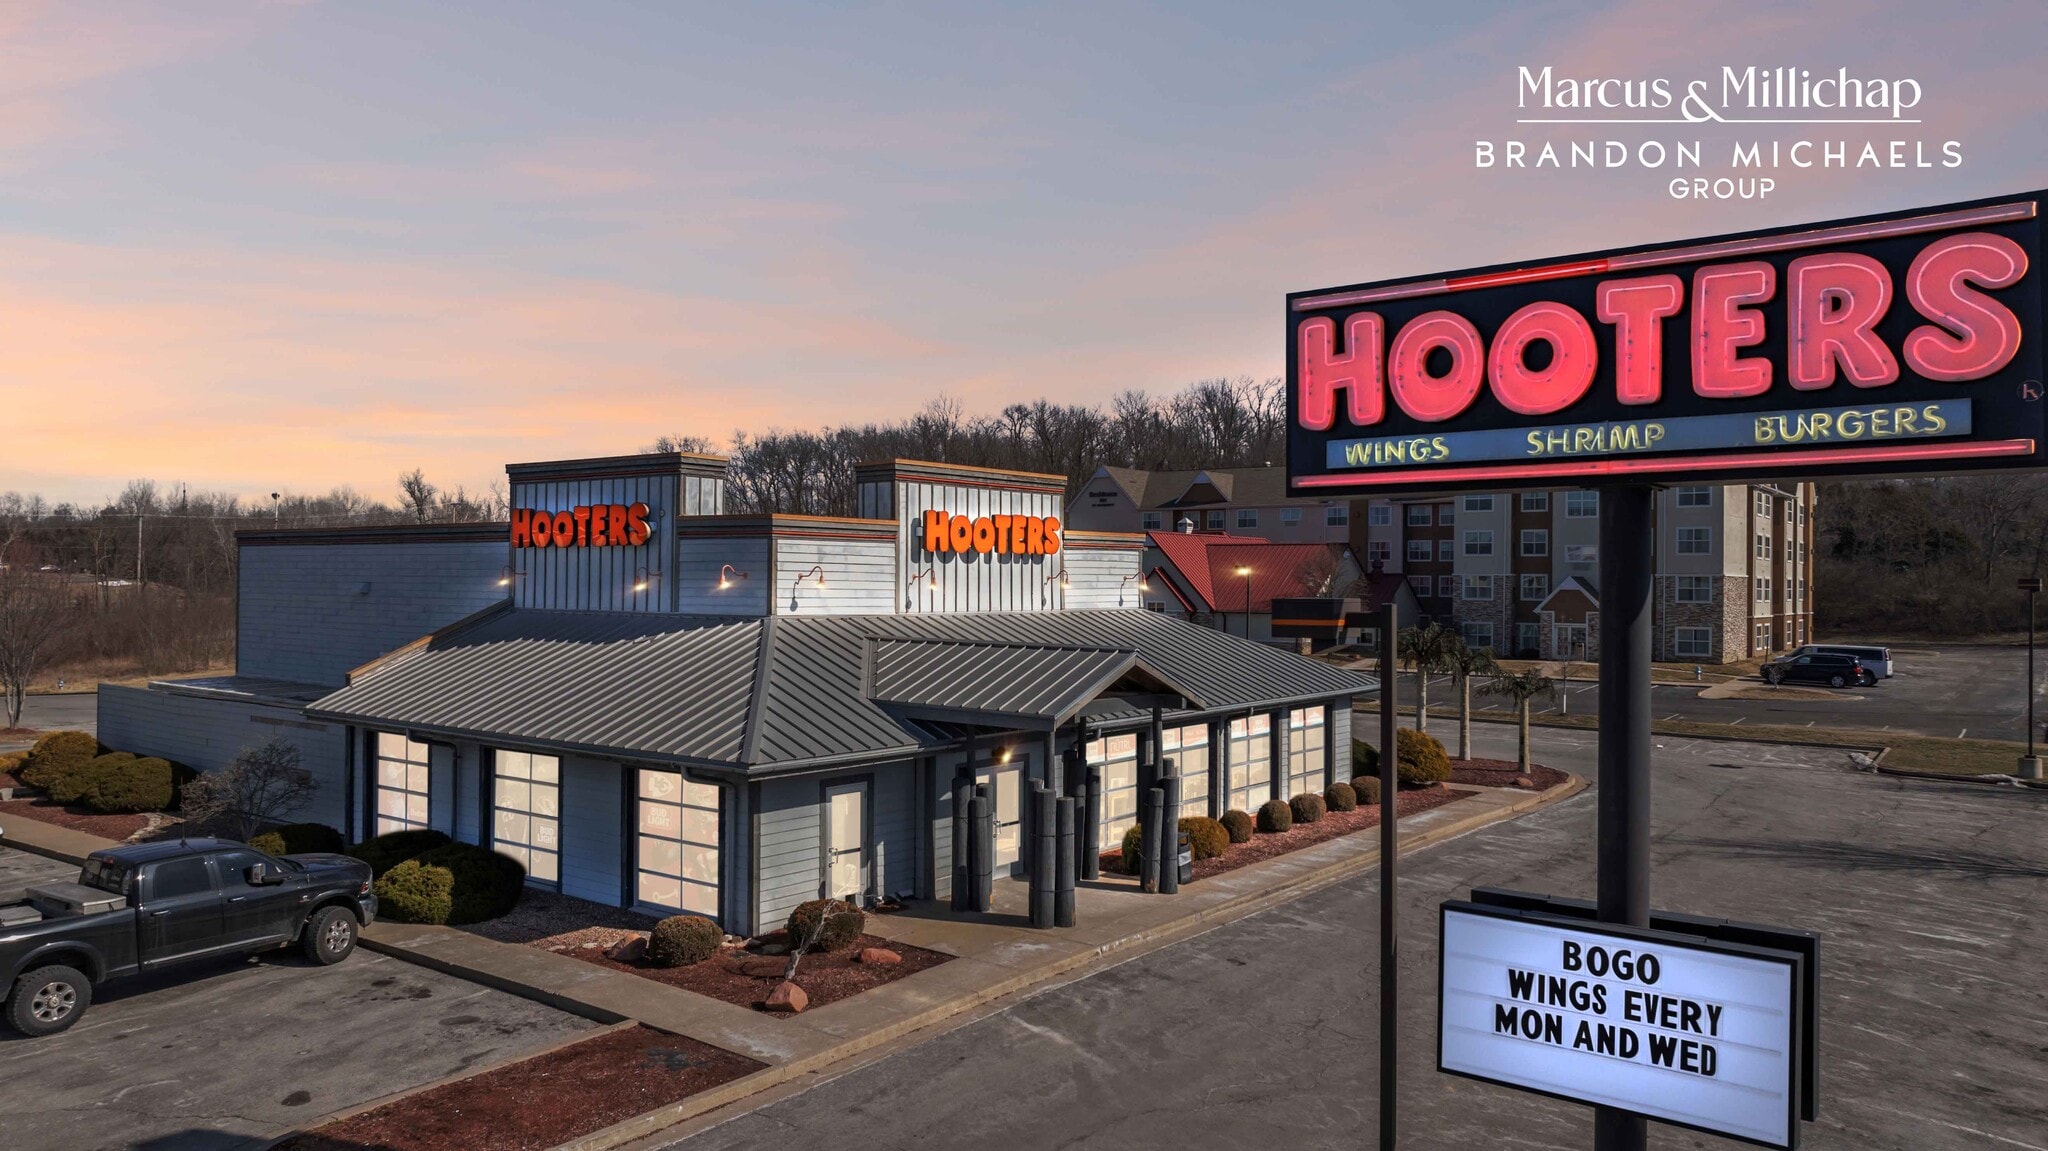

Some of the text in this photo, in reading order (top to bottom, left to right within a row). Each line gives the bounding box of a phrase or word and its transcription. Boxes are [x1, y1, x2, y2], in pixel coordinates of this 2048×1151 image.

[1297, 231, 2030, 431] HOOTERS
[1345, 405, 1946, 465] WINGS SHRIMP BURGERS
[511, 503, 652, 548] HOOTERS
[924, 509, 1061, 555] HOOTERS
[1562, 940, 1661, 985] BOGO
[1508, 968, 1723, 1037] WINGS EVERY
[1495, 1003, 1718, 1077] MON AND WED
